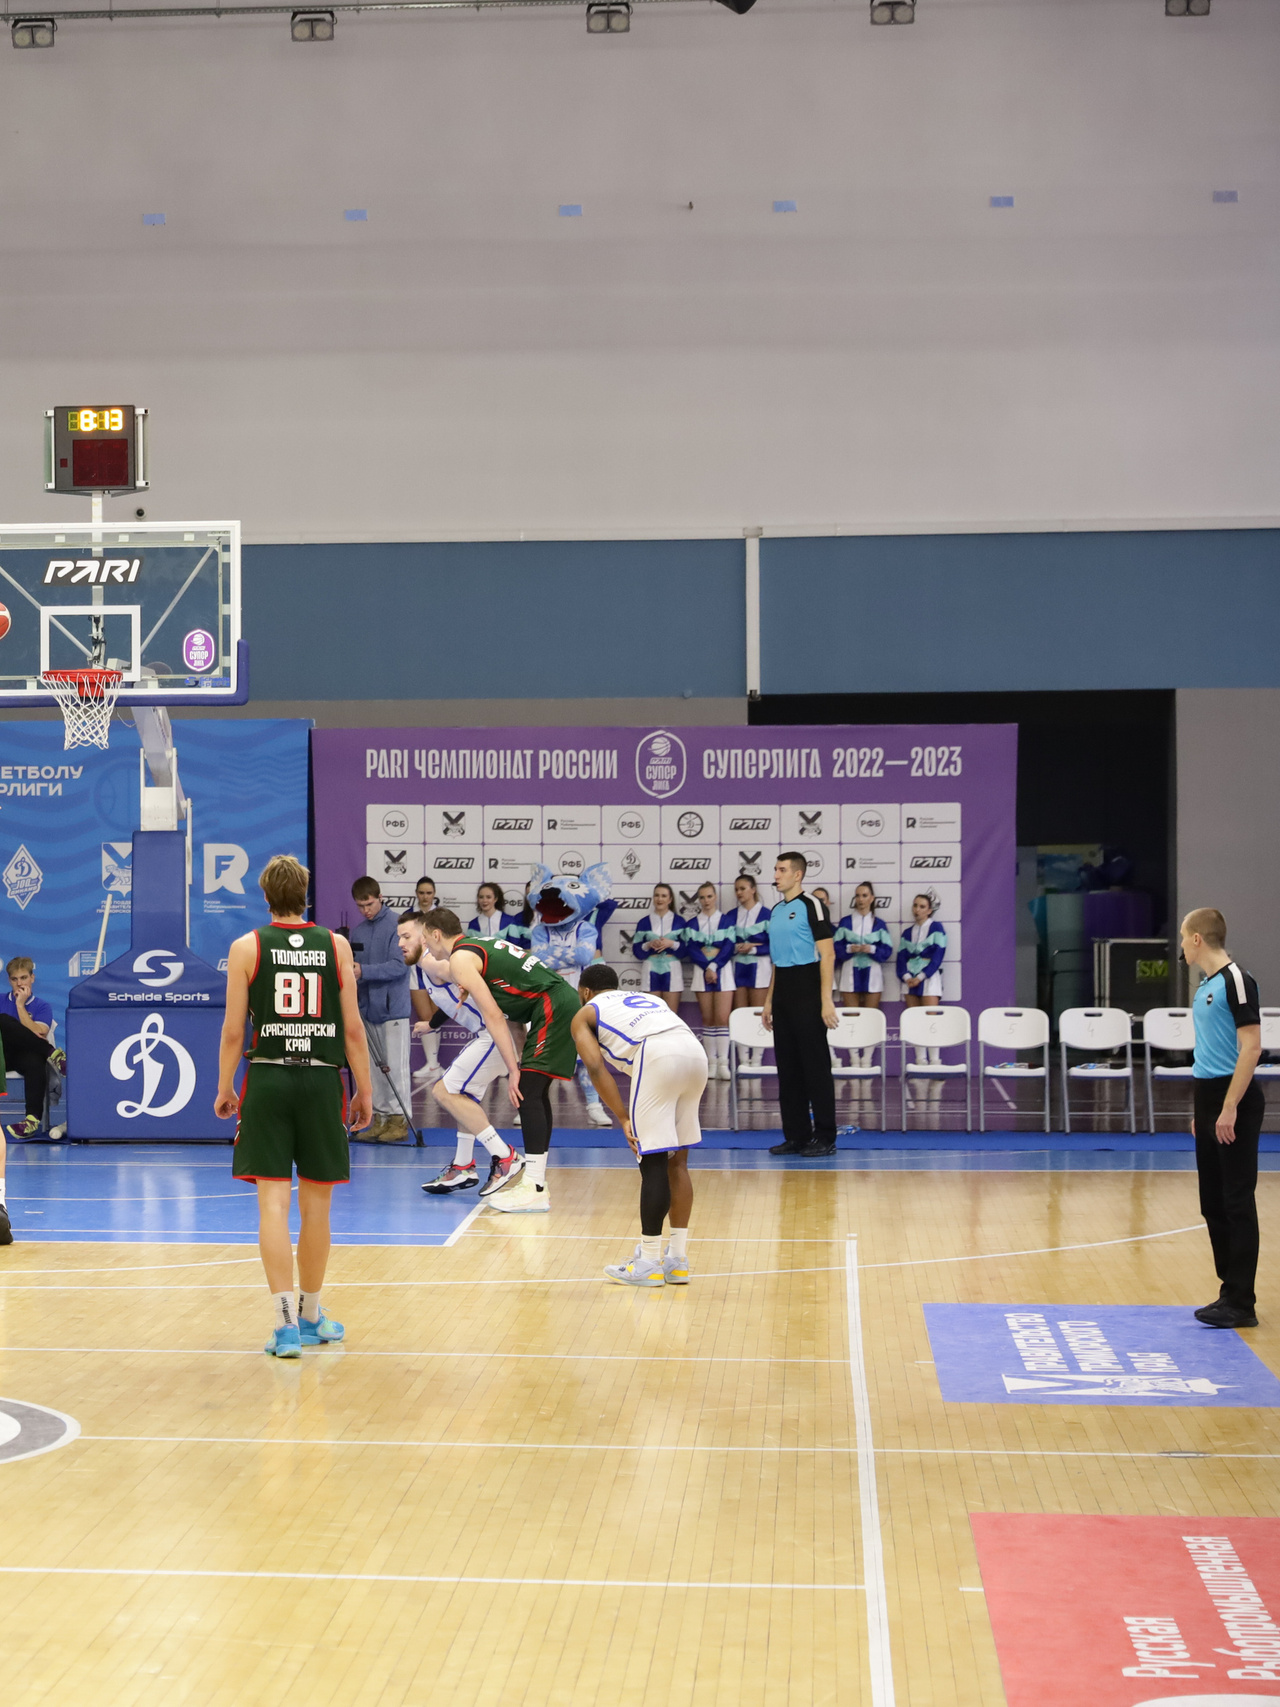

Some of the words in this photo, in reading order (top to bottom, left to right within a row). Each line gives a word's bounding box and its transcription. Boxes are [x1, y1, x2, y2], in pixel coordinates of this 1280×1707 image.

[43, 559, 140, 584] PARI
[366, 749, 408, 778] PARI
[539, 749, 617, 779] РОССИИ
[703, 749, 822, 779] СУПЕРЛИГА
[385, 819, 406, 828] РФБ
[492, 818, 533, 830] PARI
[621, 820, 641, 829] РФБ
[729, 818, 771, 830] PARI
[861, 819, 881, 828] РФБ
[433, 857, 475, 869] PARI
[562, 859, 582, 868] РФБ
[670, 857, 711, 869] PARI
[910, 856, 952, 868] PARI
[613, 897, 652, 909] PARI
[850, 896, 892, 908] PRI
[270, 949, 327, 967] ТЮЛЮБАЕВ
[108, 992, 163, 1001] Schelde
[164, 992, 210, 1003] Sports
[274, 972, 322, 1018] 81
[260, 1023, 336, 1038] КРАСНОДАРСКИЙ
[285, 1038, 311, 1052] КРАЙ
[1121, 1616, 1216, 1679] Русская
